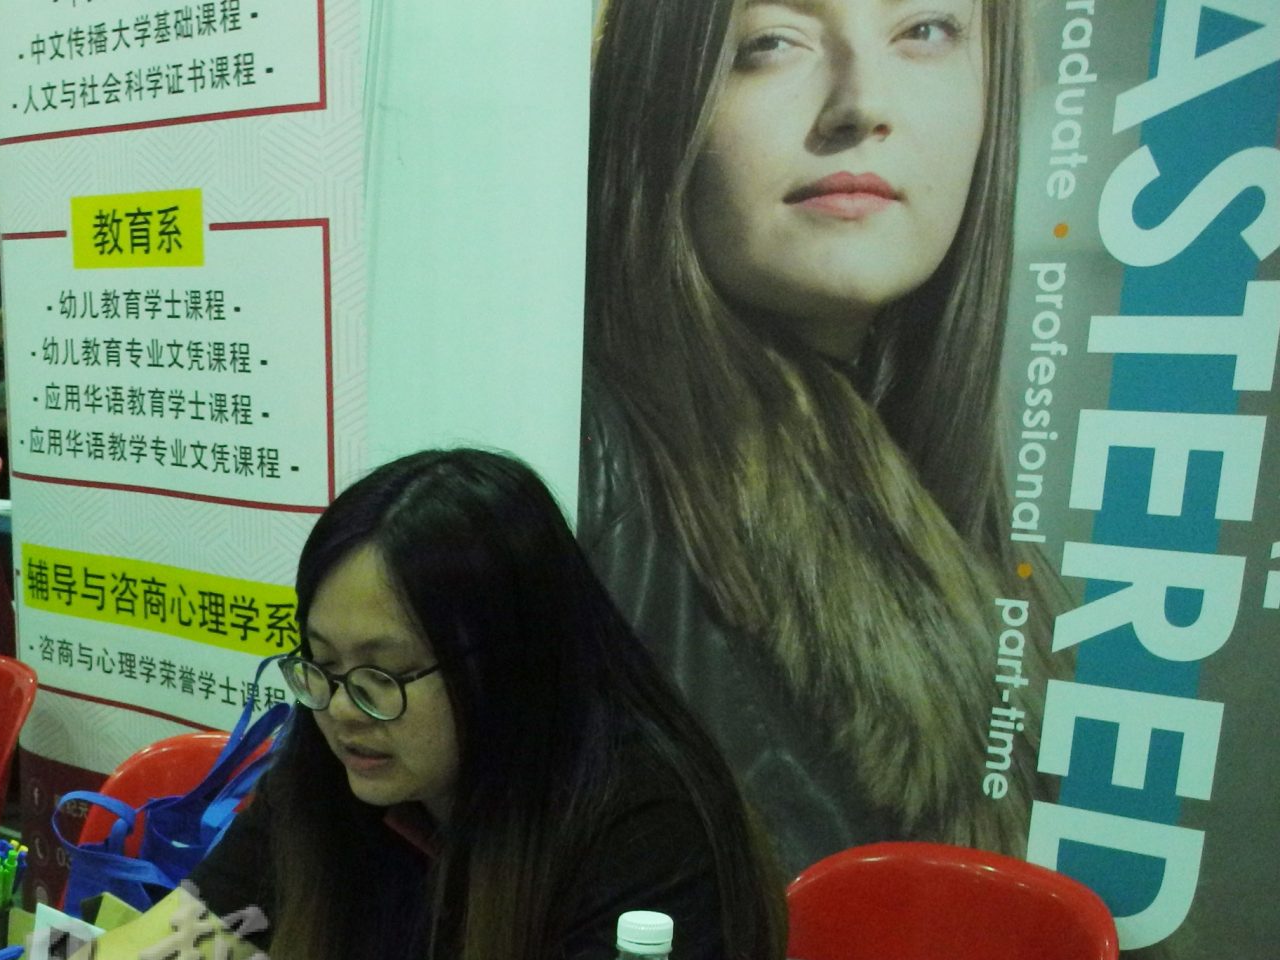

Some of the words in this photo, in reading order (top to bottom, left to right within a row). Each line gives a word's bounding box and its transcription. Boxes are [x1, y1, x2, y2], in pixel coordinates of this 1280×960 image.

[30, 0, 242, 65] 中文传播大学基础课程
[24, 53, 257, 114] 人文与社会科学证书课程
[93, 206, 183, 256] 教育系
[59, 289, 227, 321] 幼儿教育学士课程
[42, 337, 252, 374] 幼儿教育专业文凭课程
[44, 382, 253, 425] 应用华语教育学士课程
[1010, 263, 1068, 543] professional
[29, 426, 281, 479] 应用华语教学专业文凭课程
[27, 557, 299, 648] 辅导与咨商心理学系
[39, 635, 287, 714] 咨商与心理学荣誉学士课程
[982, 598, 1029, 800] part-time
